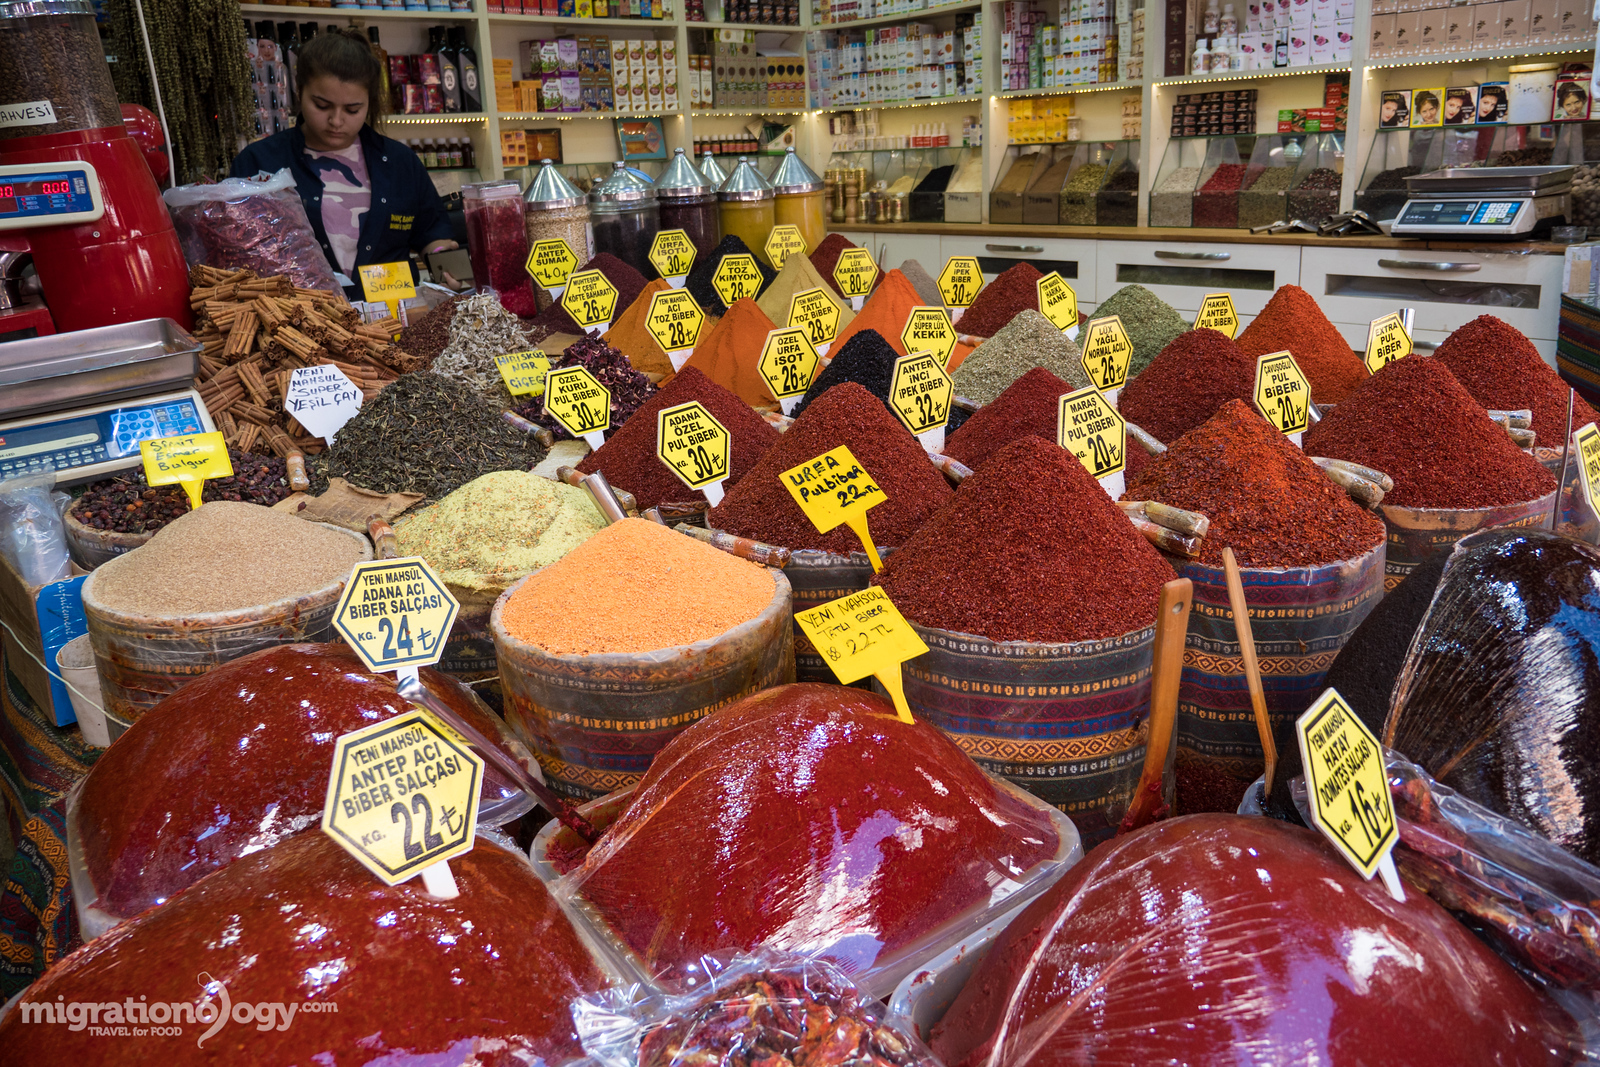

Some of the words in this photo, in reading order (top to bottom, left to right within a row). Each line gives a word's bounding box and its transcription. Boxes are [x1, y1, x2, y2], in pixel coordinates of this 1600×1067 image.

[660, 241, 684, 249] URFA
[538, 250, 565, 258] ANTEP
[536, 256, 568, 266] SUMAK
[1047, 292, 1067, 307] NANE
[667, 304, 680, 313] ACI
[801, 302, 821, 313] TATLI
[1206, 309, 1228, 317] ANTEP
[654, 315, 670, 324] TOZ
[794, 314, 809, 324] TOZ
[914, 322, 932, 330] SÜPER
[934, 321, 945, 329] LÜX
[1201, 319, 1212, 328] PUL
[1375, 322, 1398, 336] EXTRA
[778, 336, 799, 345] ÖZEL
[1095, 334, 1117, 346] YAĞLI
[1380, 333, 1395, 345] PUL
[777, 345, 801, 354] URFA
[1088, 345, 1111, 360] NORMAL
[558, 375, 581, 384] ÖZEL
[1271, 372, 1289, 383] PUL
[558, 381, 588, 394] KURU
[334, 390, 356, 406] ÇAY
[554, 395, 572, 405] PUL
[1070, 398, 1096, 414] MARAŞ
[669, 411, 701, 427] ADANA
[1072, 407, 1102, 425] KURU
[674, 421, 704, 436] ÖZEL
[1067, 427, 1086, 442] PUL
[668, 439, 688, 452] PUL
[158, 458, 209, 471] Bulgur
[385, 568, 422, 583] MAHSÜL
[363, 587, 402, 603] ADANA
[406, 583, 426, 597] ACI
[390, 595, 442, 615] SALÇASI
[358, 631, 376, 642] KG.
[846, 632, 877, 656] 22
[870, 624, 893, 636] TL
[1322, 709, 1346, 738] MAHSÜL
[382, 727, 428, 755] MAHSÜL
[1322, 731, 1350, 771] HATAY
[351, 759, 406, 792] ANTEP
[414, 742, 442, 762] ACI
[1320, 765, 1350, 807] DOMATES
[1346, 737, 1371, 776] SALÇASI
[396, 754, 462, 797] SALÇASI
[1339, 820, 1352, 837] KG.
[361, 830, 386, 847] KG.
